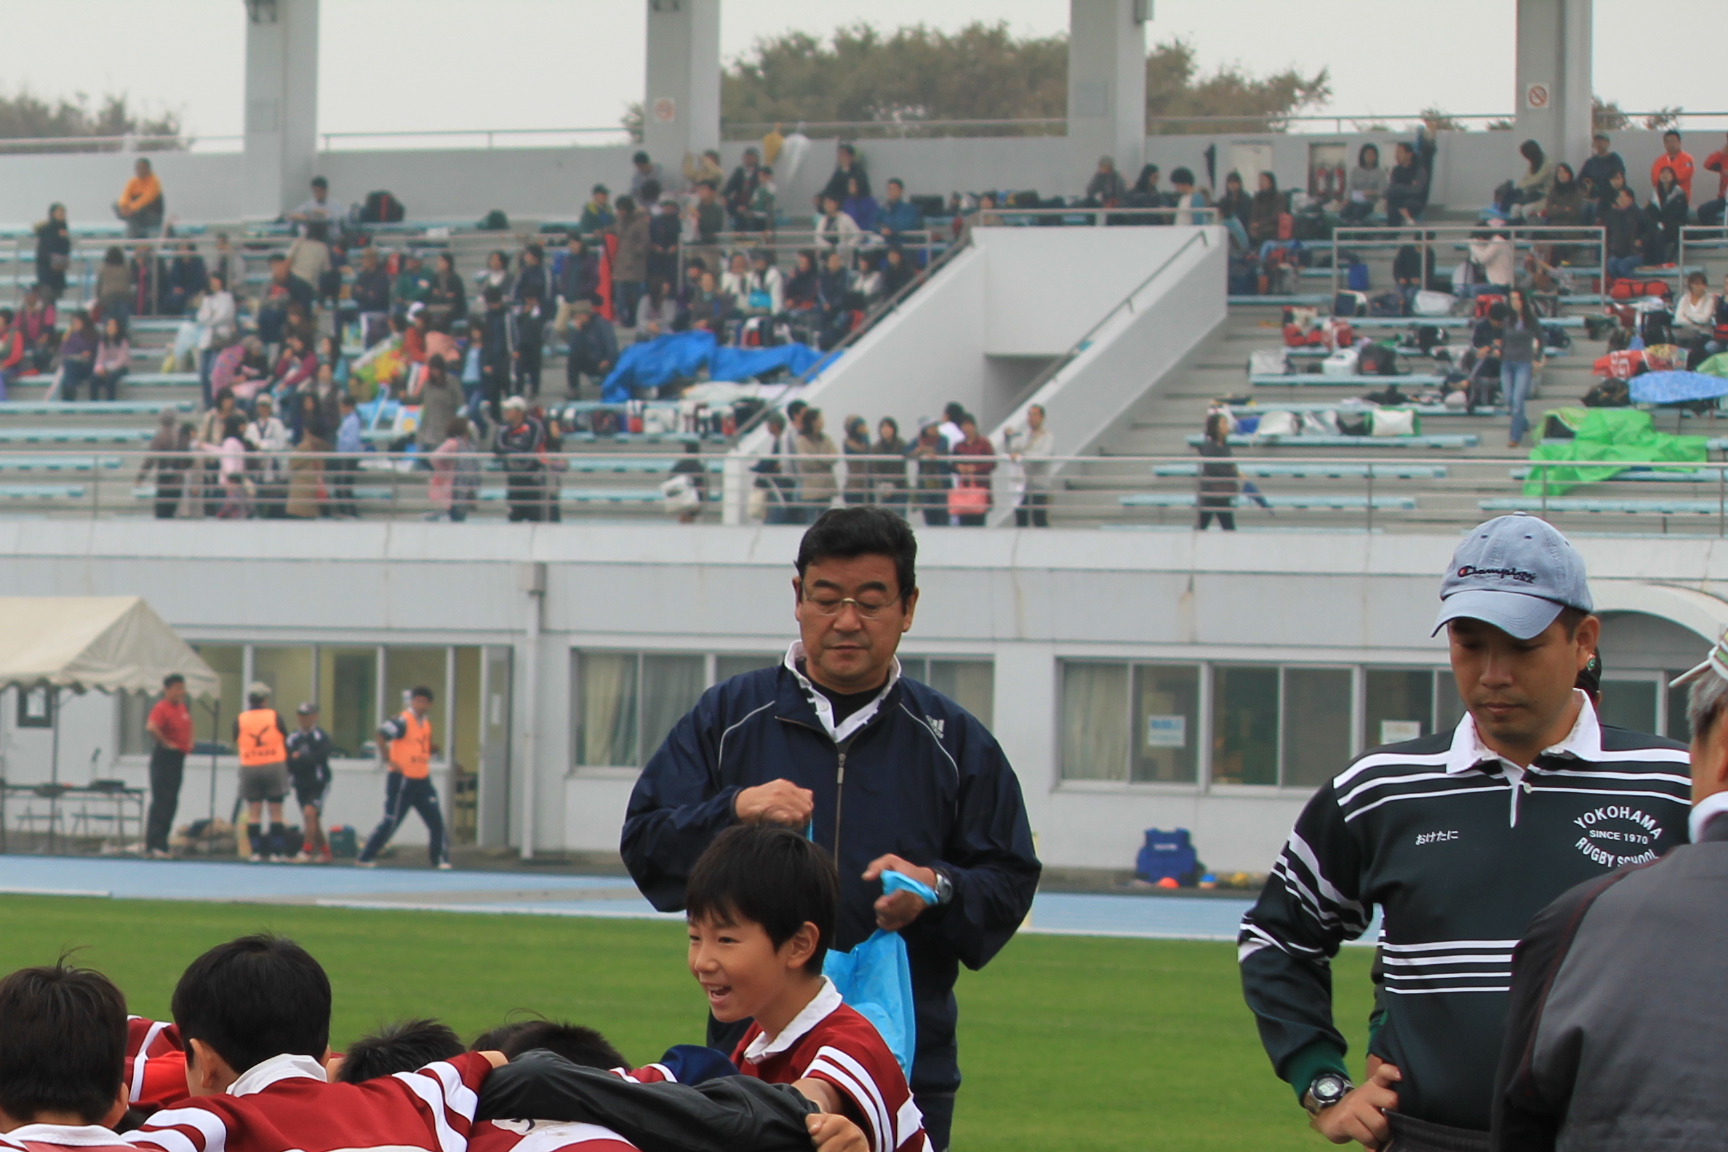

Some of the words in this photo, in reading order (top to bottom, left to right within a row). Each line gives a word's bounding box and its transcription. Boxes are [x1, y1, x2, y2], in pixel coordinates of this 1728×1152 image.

[1457, 565, 1537, 580] Champion
[1573, 805, 1663, 840] YOKOHAMA
[1415, 830, 1459, 846] おけたに
[1589, 829, 1621, 841] SINCE
[1623, 833, 1649, 845] 1970
[1574, 836, 1616, 868] RUGBY
